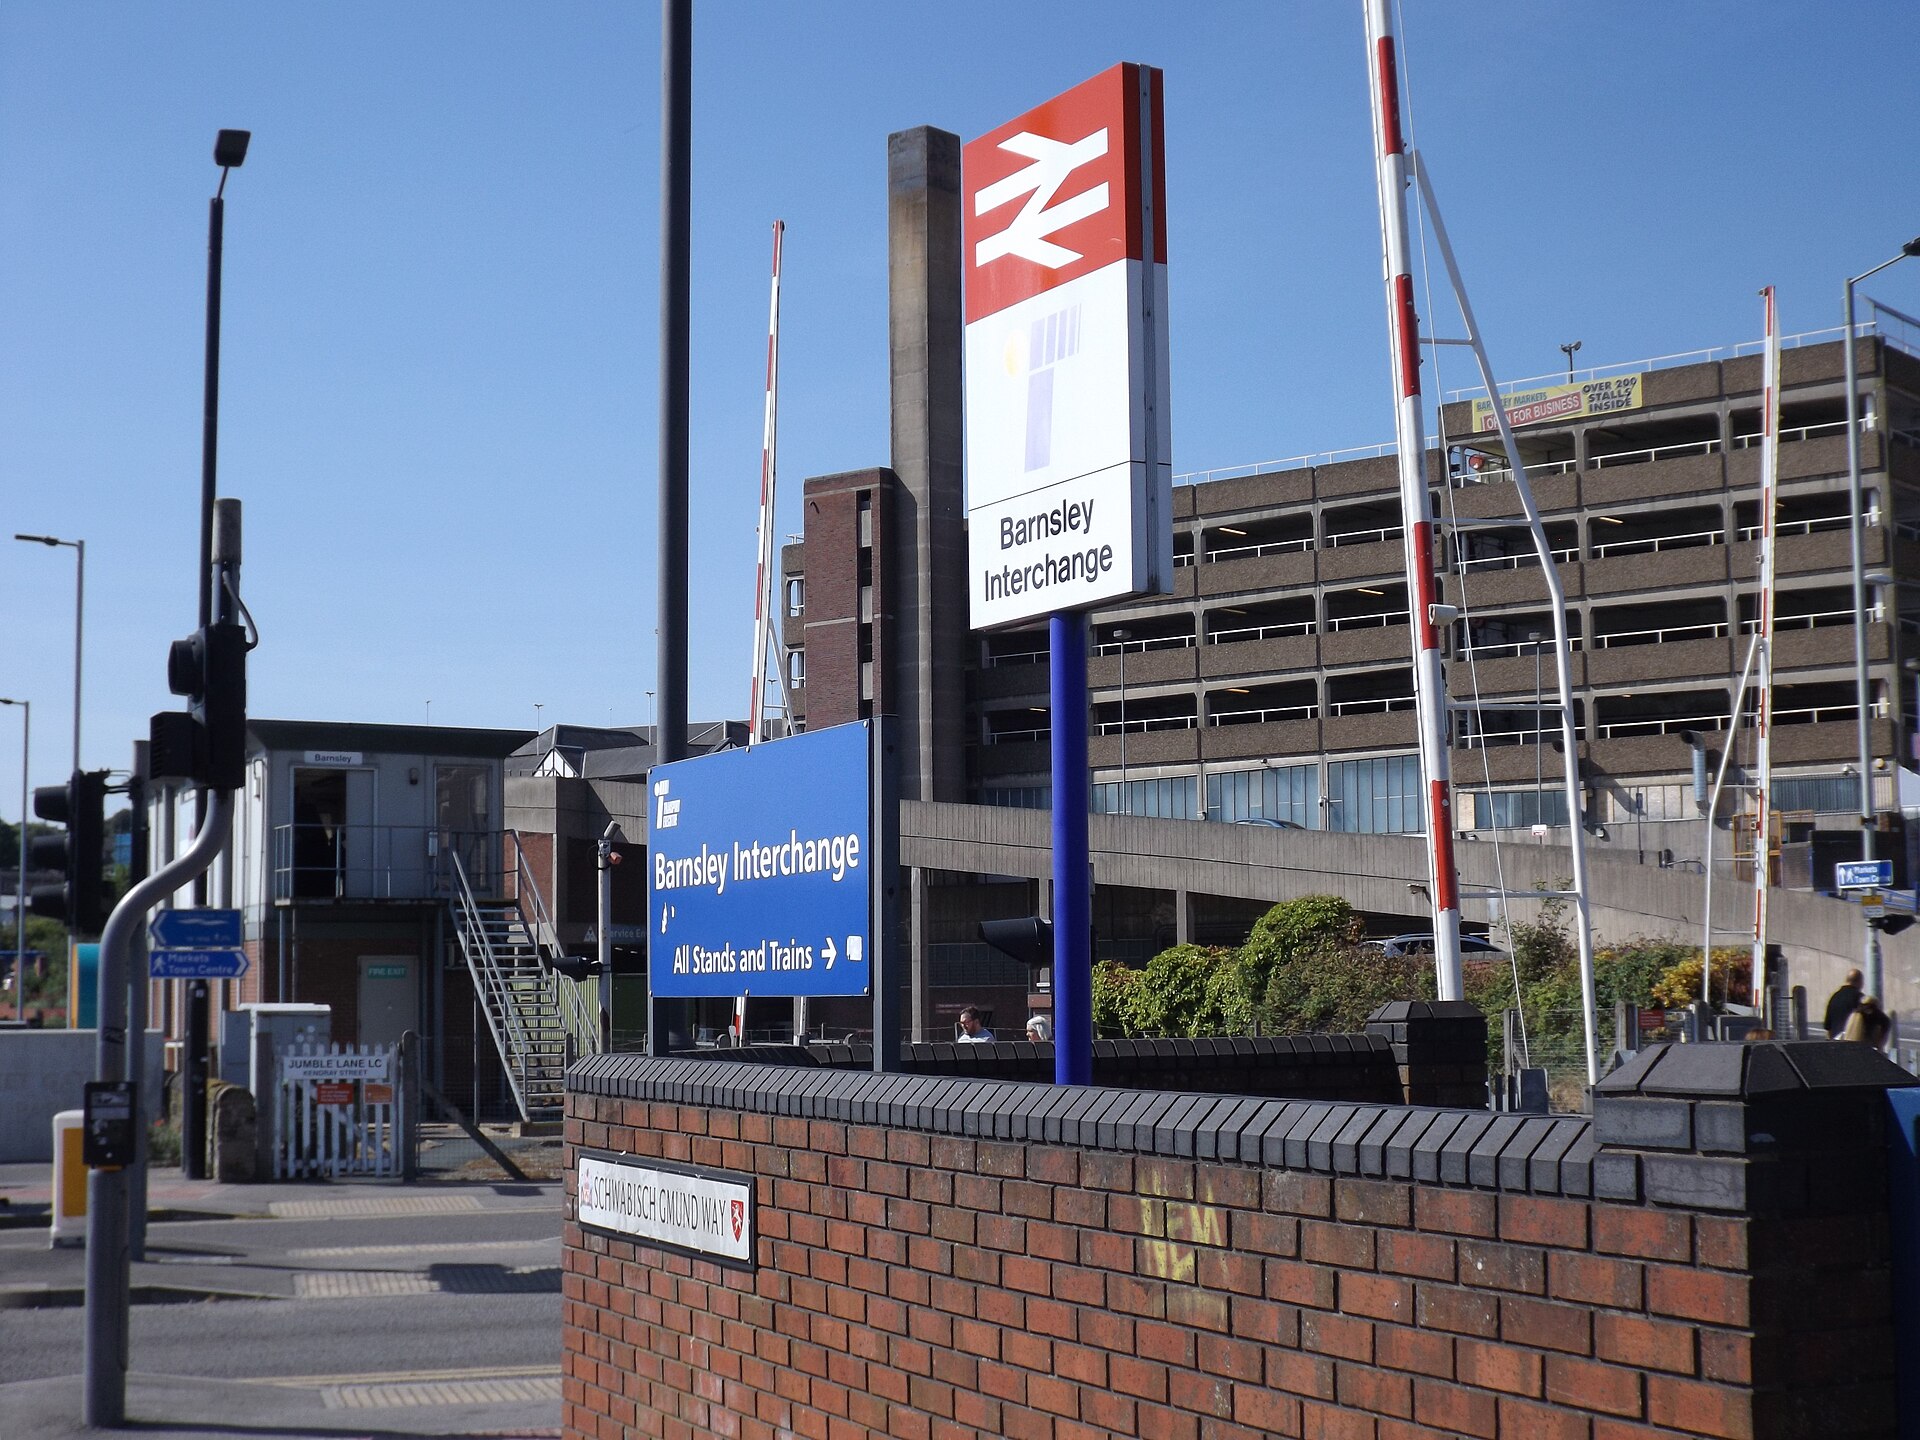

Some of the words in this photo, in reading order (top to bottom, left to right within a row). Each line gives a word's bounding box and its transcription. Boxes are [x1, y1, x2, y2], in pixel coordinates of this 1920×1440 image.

[1582, 381, 1612, 393] OVER
[1616, 377, 1637, 388] 200
[1477, 397, 1512, 412] BAREY
[1514, 392, 1548, 407] MARKETS
[1588, 388, 1631, 402] STALLS
[1486, 413, 1511, 429] OPN
[1513, 409, 1532, 423] FOR
[1533, 395, 1579, 418] BUSINESS
[1589, 399, 1631, 412] INSIDE
[1000, 498, 1094, 550] Barnsley
[985, 544, 1113, 602] Interchange
[315, 753, 352, 763] Barnsley
[655, 843, 729, 895] Barnsley
[733, 829, 859, 882] Interchange
[167, 953, 209, 963] Markets
[673, 944, 690, 974] All
[693, 942, 736, 974] Stands
[739, 940, 766, 973] and
[769, 938, 813, 971] Trains
[168, 964, 195, 975] Town
[198, 964, 233, 975] Centre
[368, 967, 386, 976] FIRE
[387, 967, 405, 976] EXIT
[288, 1059, 334, 1069] JUMBLE
[336, 1059, 366, 1068] LANE
[368, 1058, 382, 1068] LC
[303, 1069, 337, 1077] KENDRAY
[701, 1195, 726, 1236] WAY
